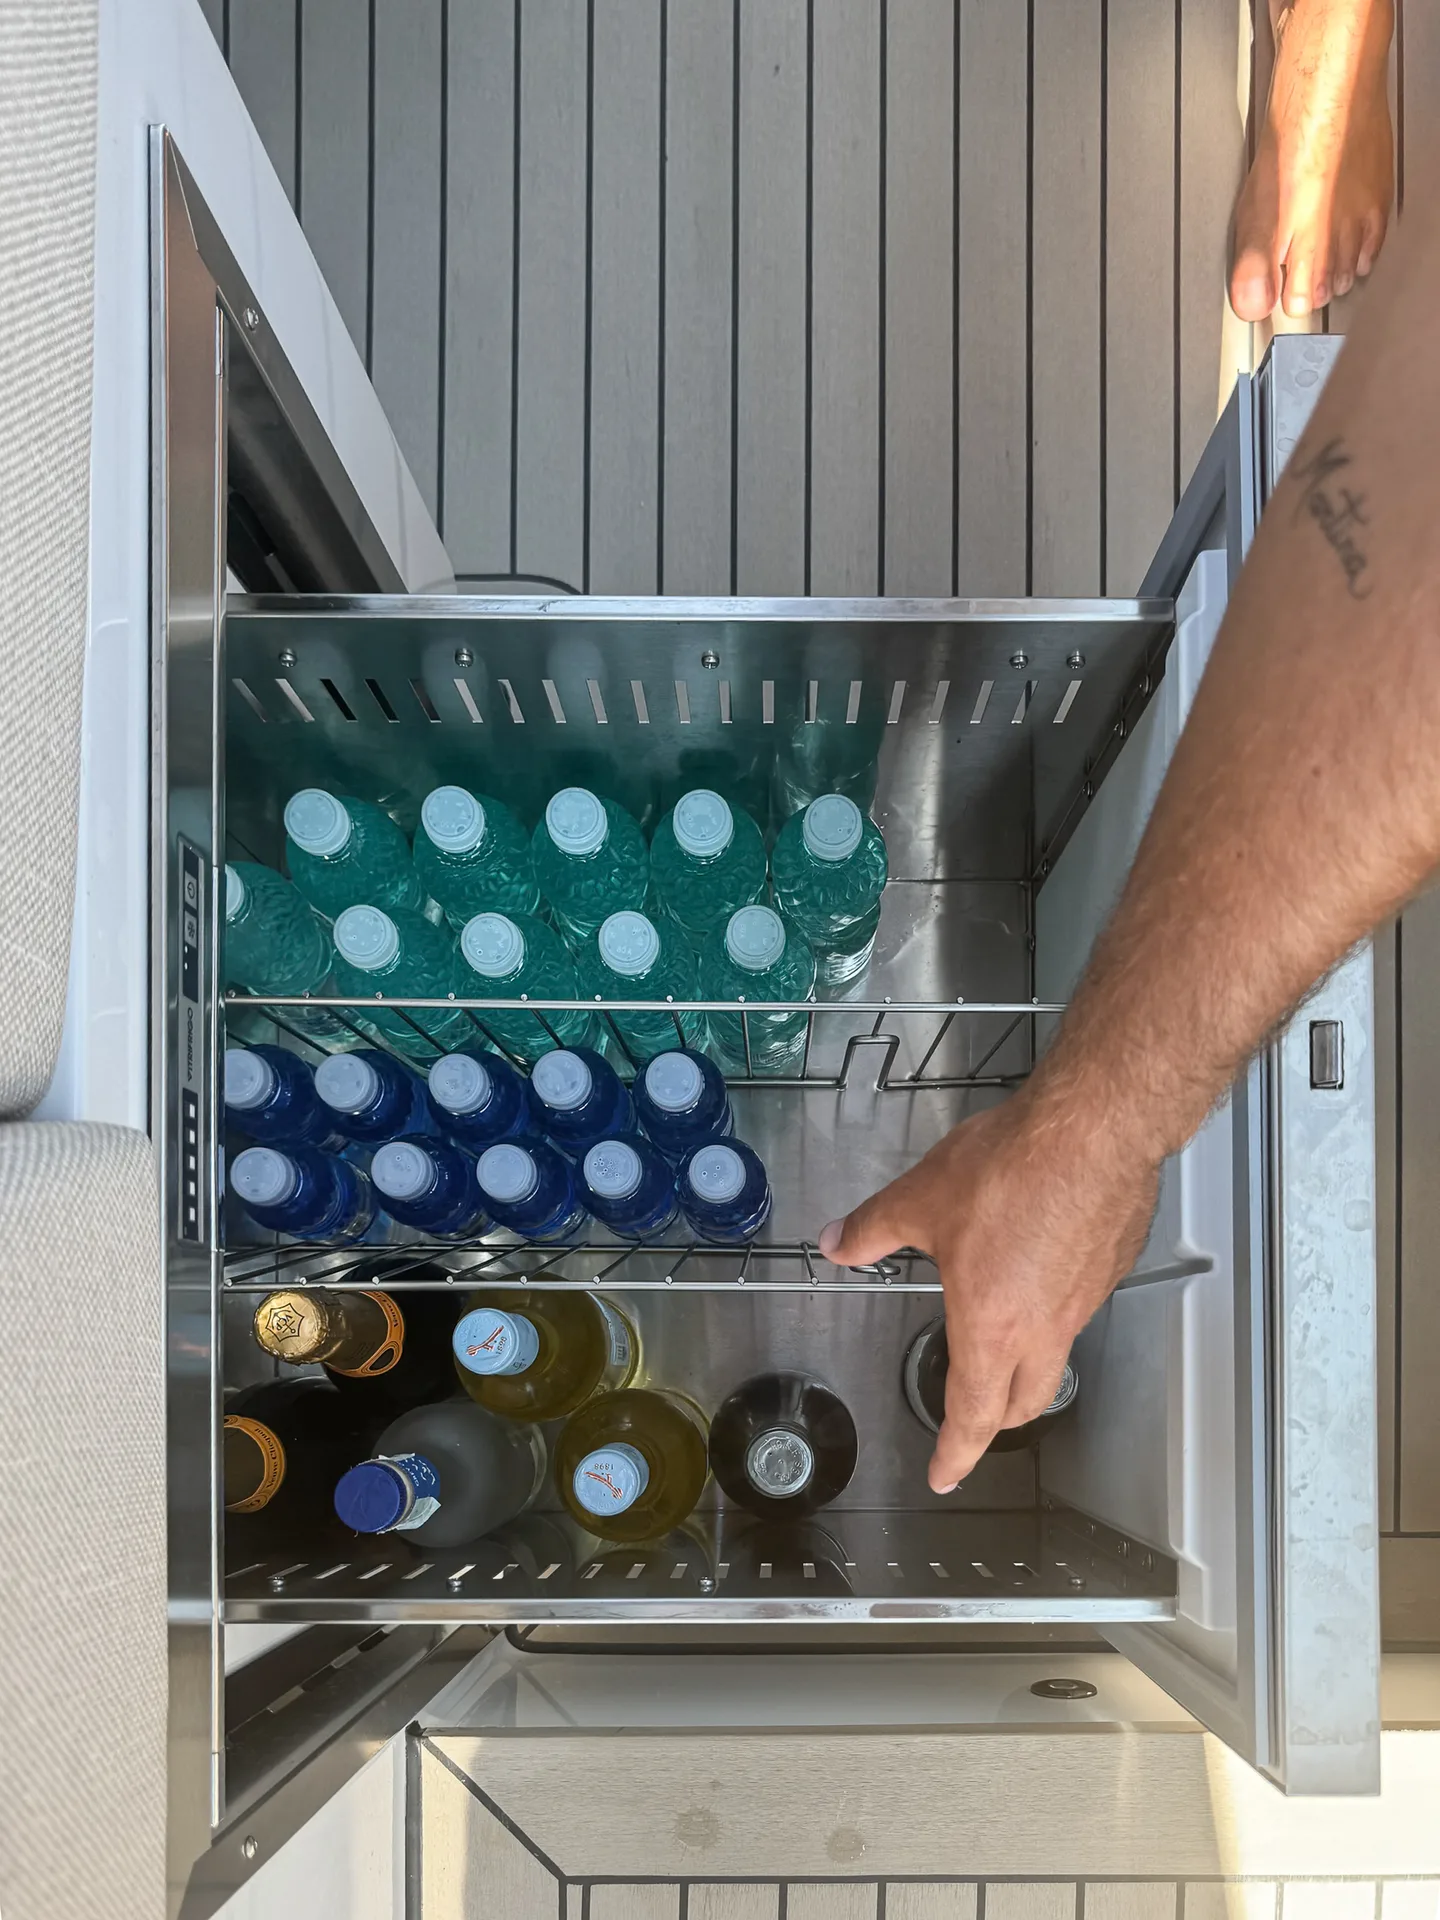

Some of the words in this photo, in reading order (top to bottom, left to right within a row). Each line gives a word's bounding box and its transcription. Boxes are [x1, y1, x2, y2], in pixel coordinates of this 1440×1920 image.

[254, 1427, 278, 1461] Clicquot
[266, 1461, 279, 1489] Veuve
[594, 1462, 614, 1471] 1898
